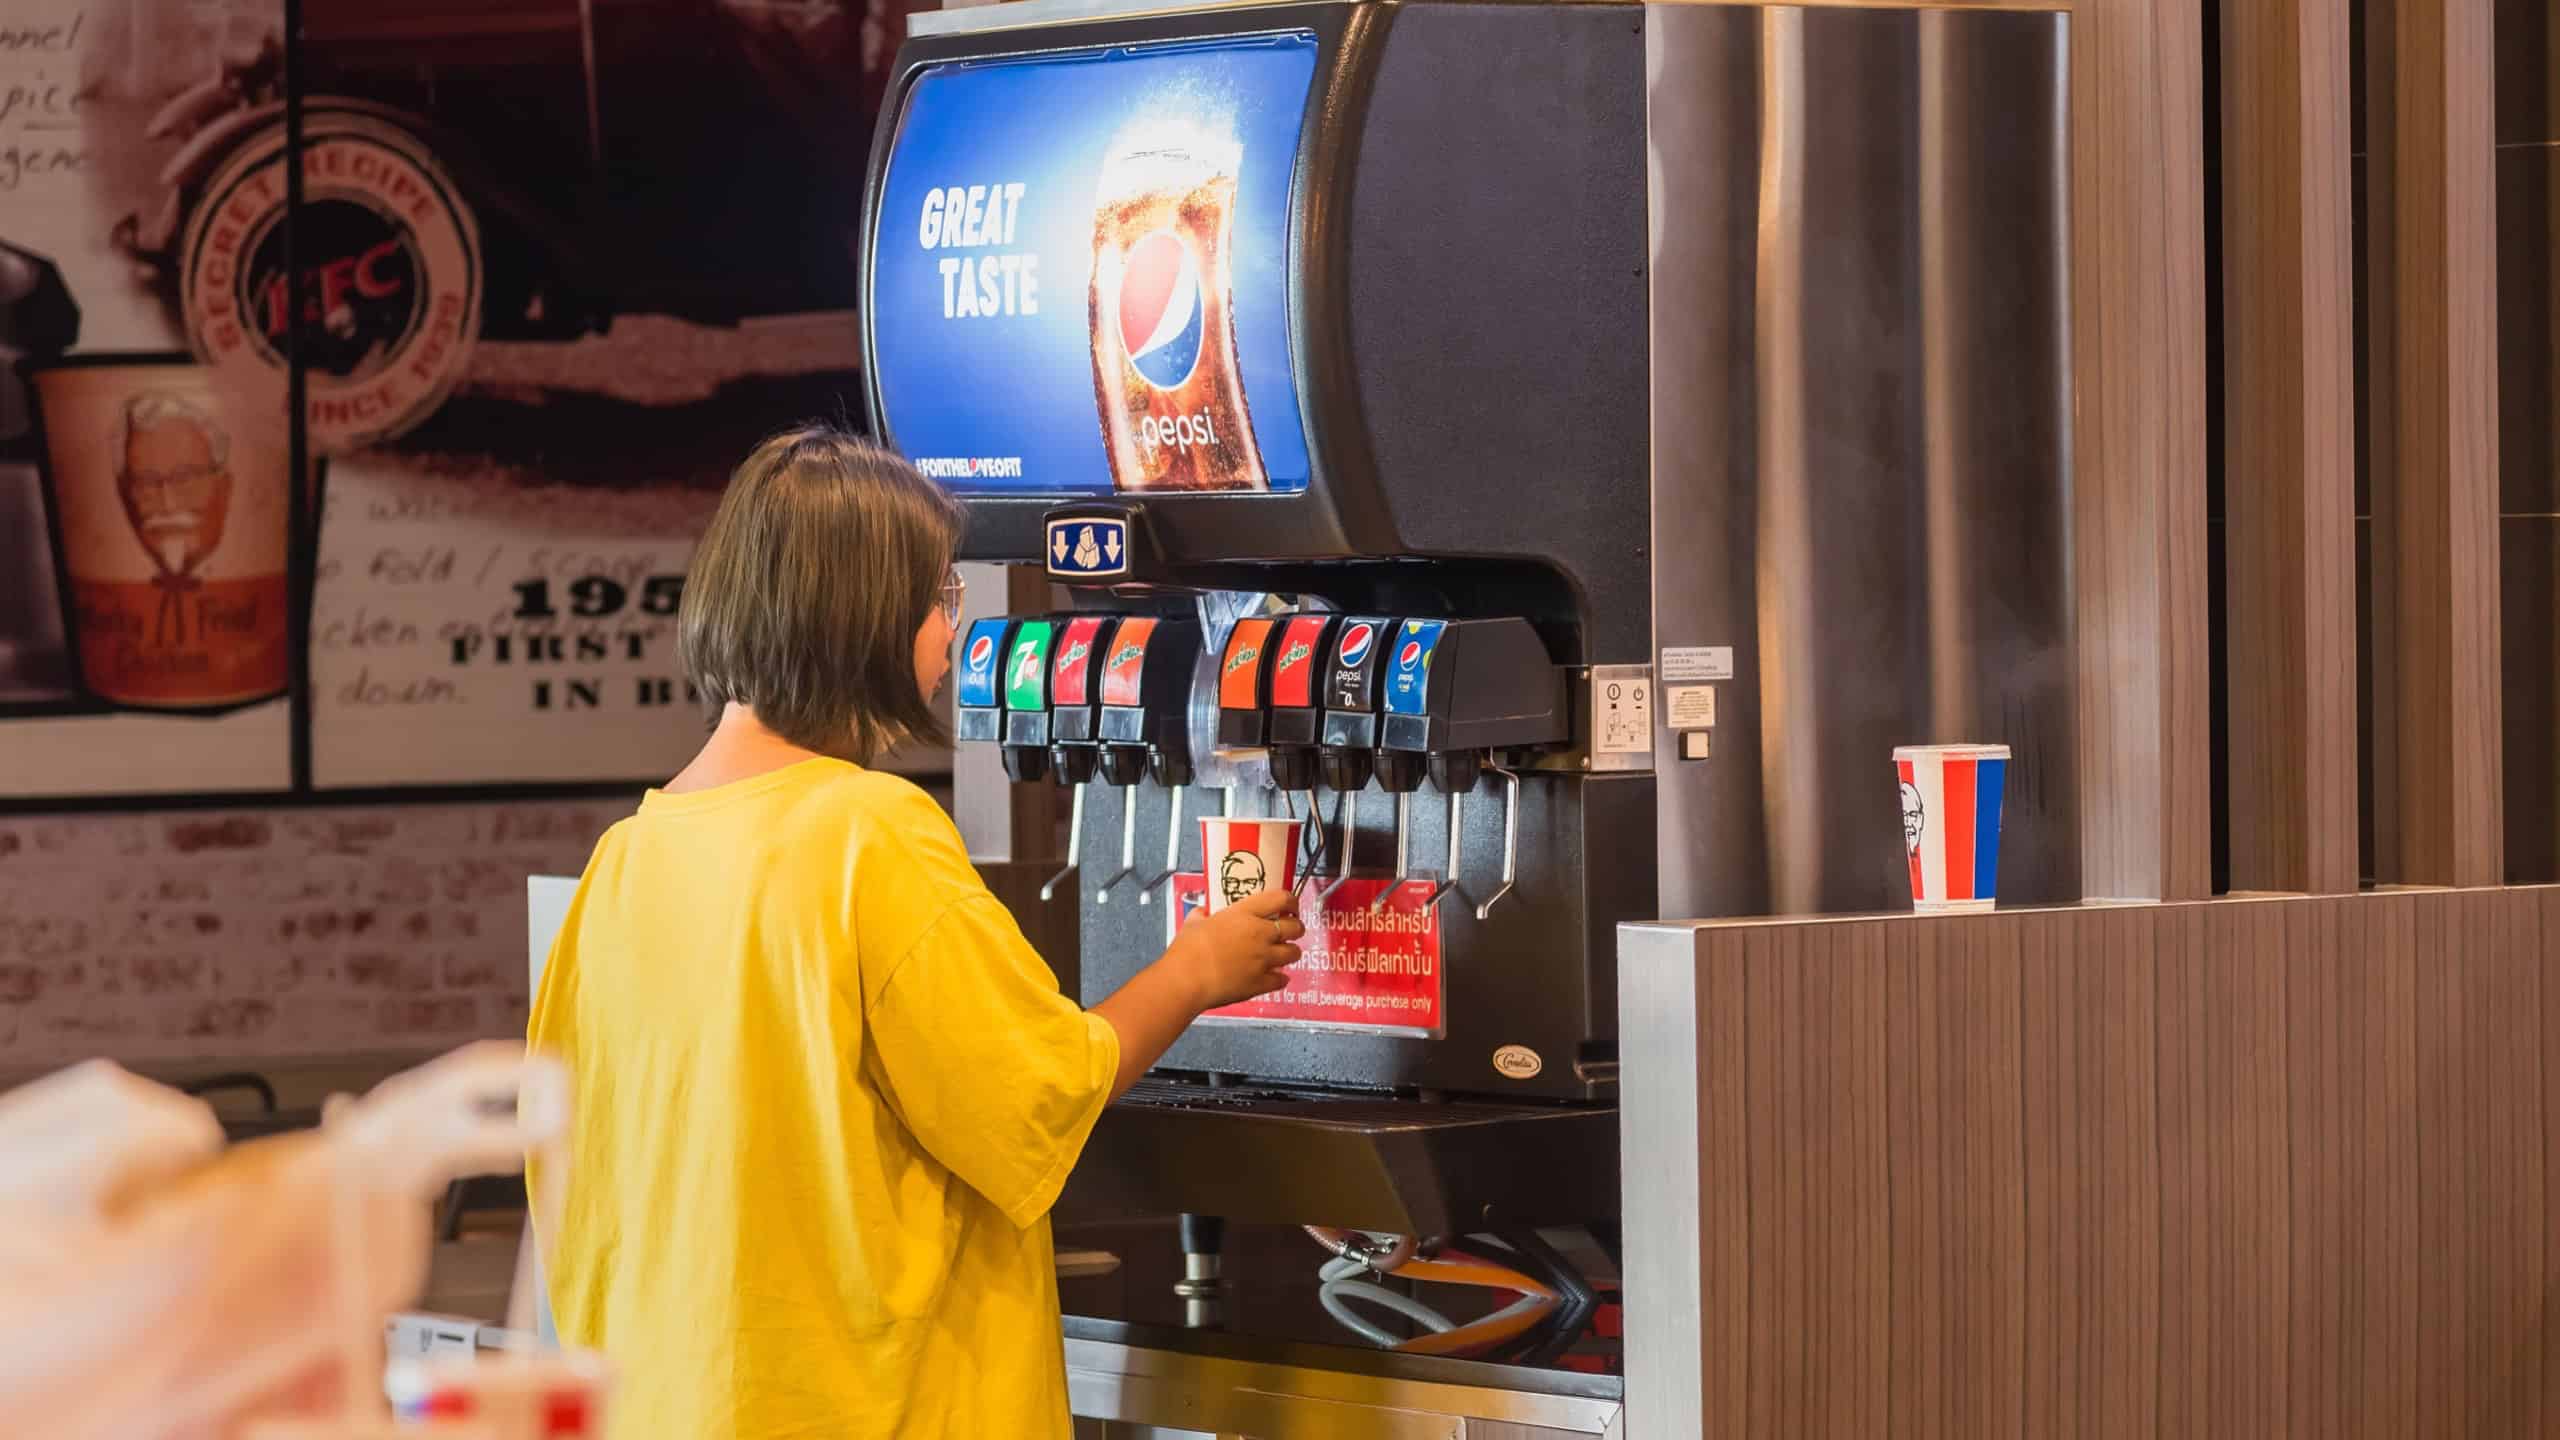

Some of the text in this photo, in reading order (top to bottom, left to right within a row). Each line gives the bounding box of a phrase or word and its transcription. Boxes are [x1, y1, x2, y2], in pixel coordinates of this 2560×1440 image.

[919, 183, 1026, 249] GREAT
[205, 174, 272, 351] SECRET
[939, 254, 1039, 319] TASTE
[283, 383, 393, 422] INCE
[1141, 407, 1217, 456] pepsi
[450, 631, 656, 665] FIRST
[532, 678, 602, 711] IN
[1336, 670, 1361, 685] pepsi
[1283, 988, 1296, 1003] for
[1365, 994, 1409, 1011] purchase
[1411, 994, 1433, 1014] only
